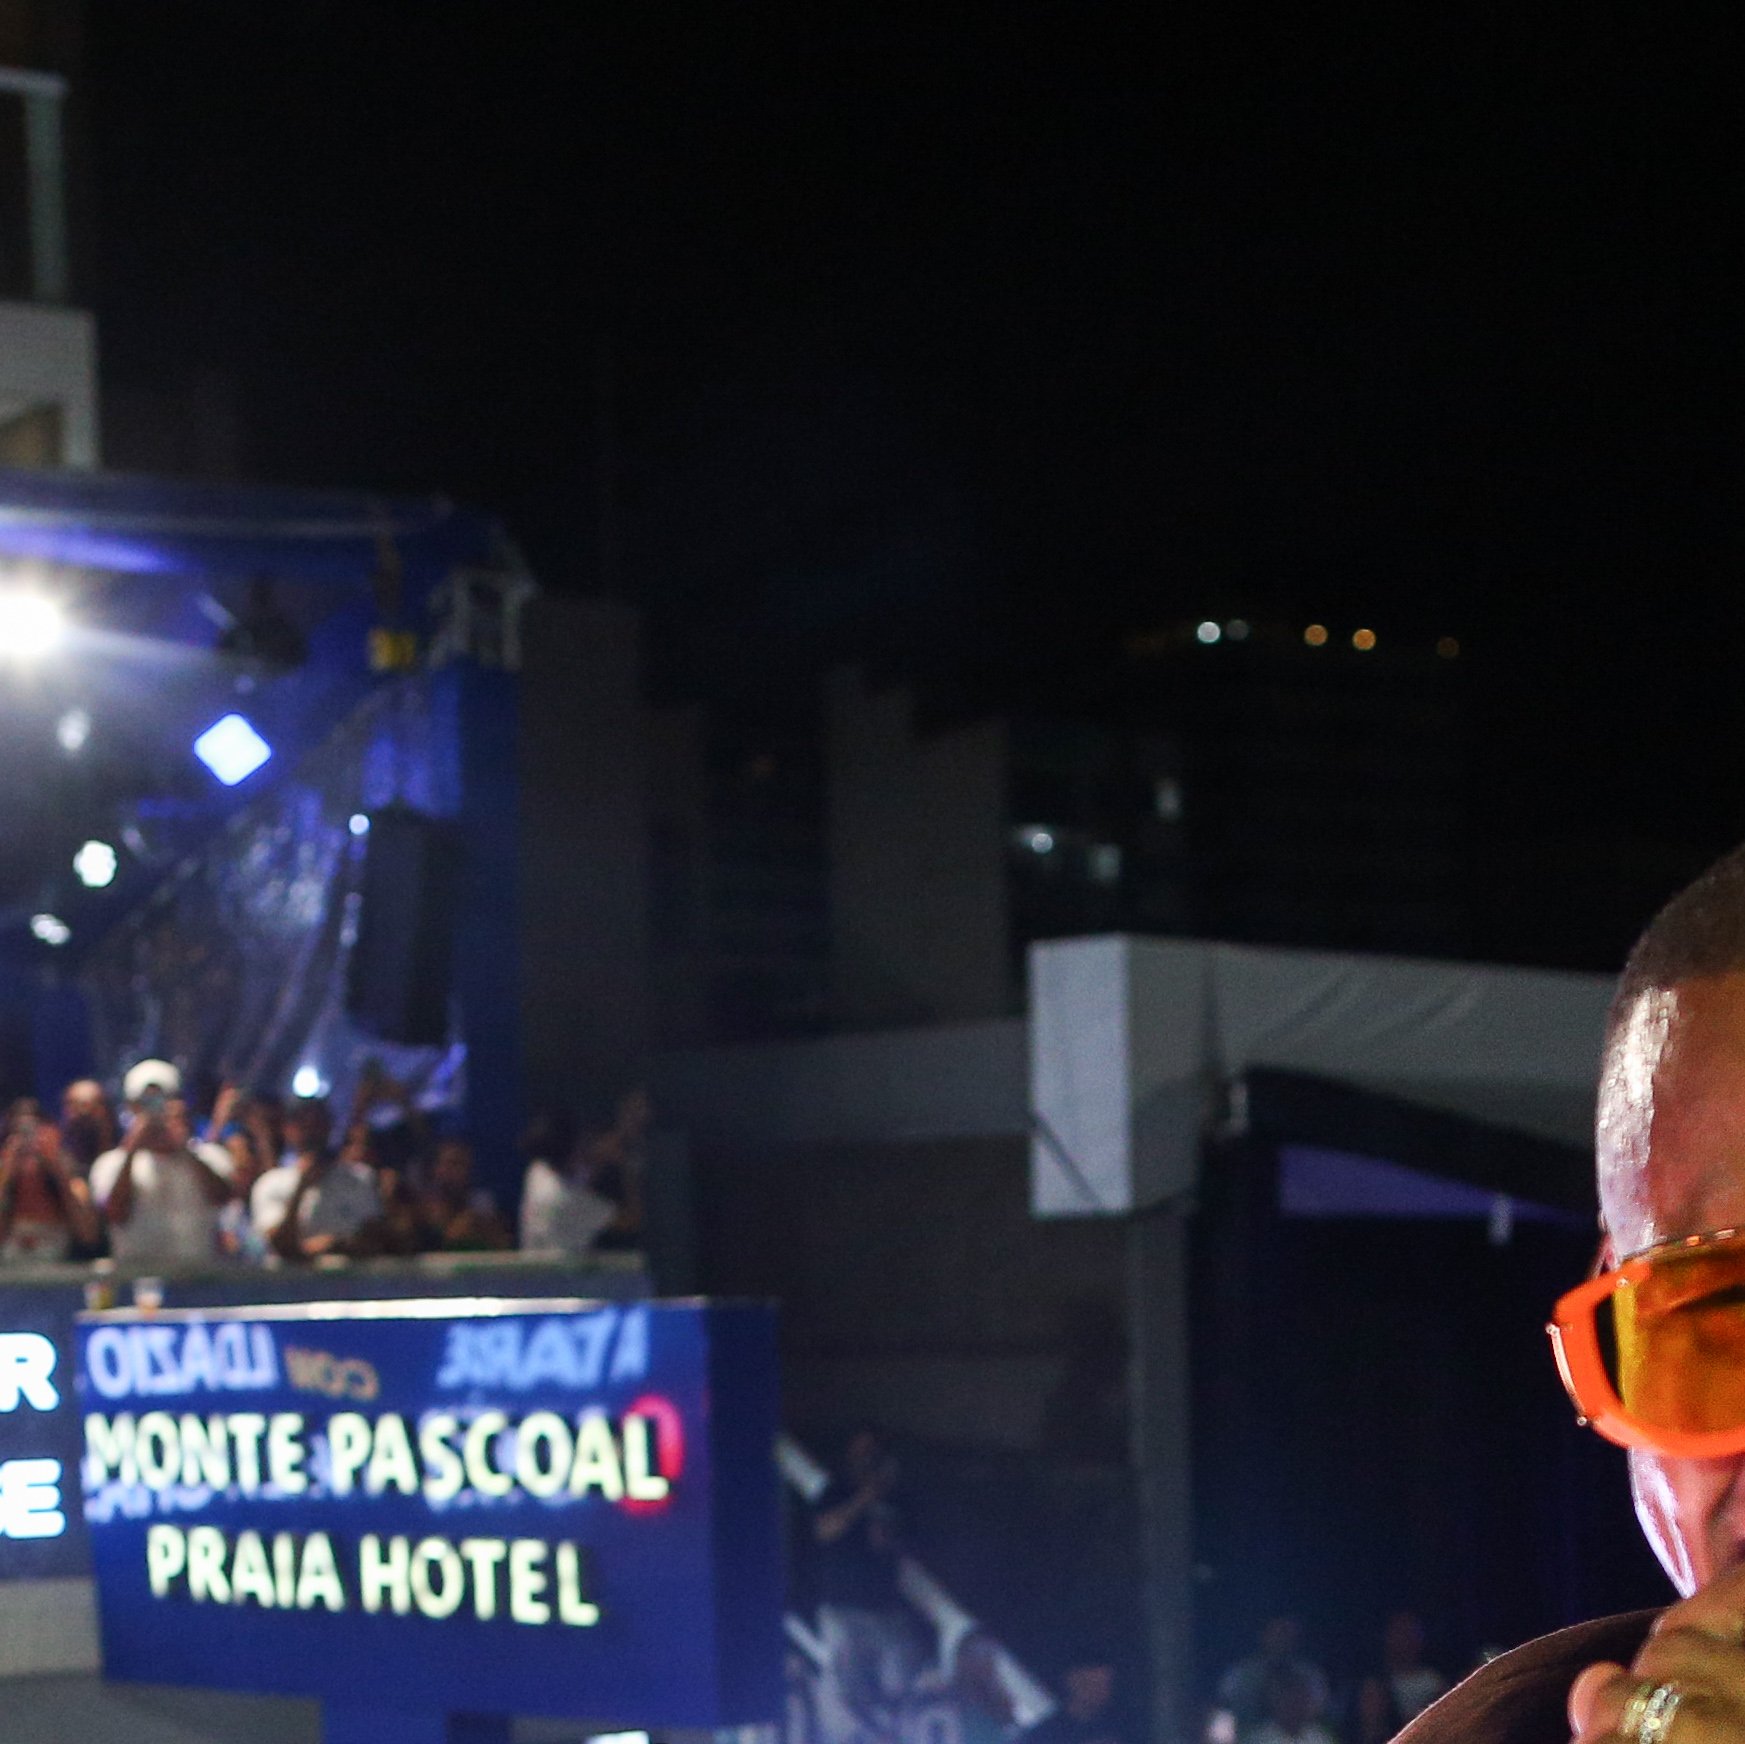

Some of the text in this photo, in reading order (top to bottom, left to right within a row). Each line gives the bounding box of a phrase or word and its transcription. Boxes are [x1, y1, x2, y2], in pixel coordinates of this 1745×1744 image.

[82, 1410, 669, 1501] MONTE PASCOAL
[147, 1523, 600, 1628] PRAIA HOTEL
